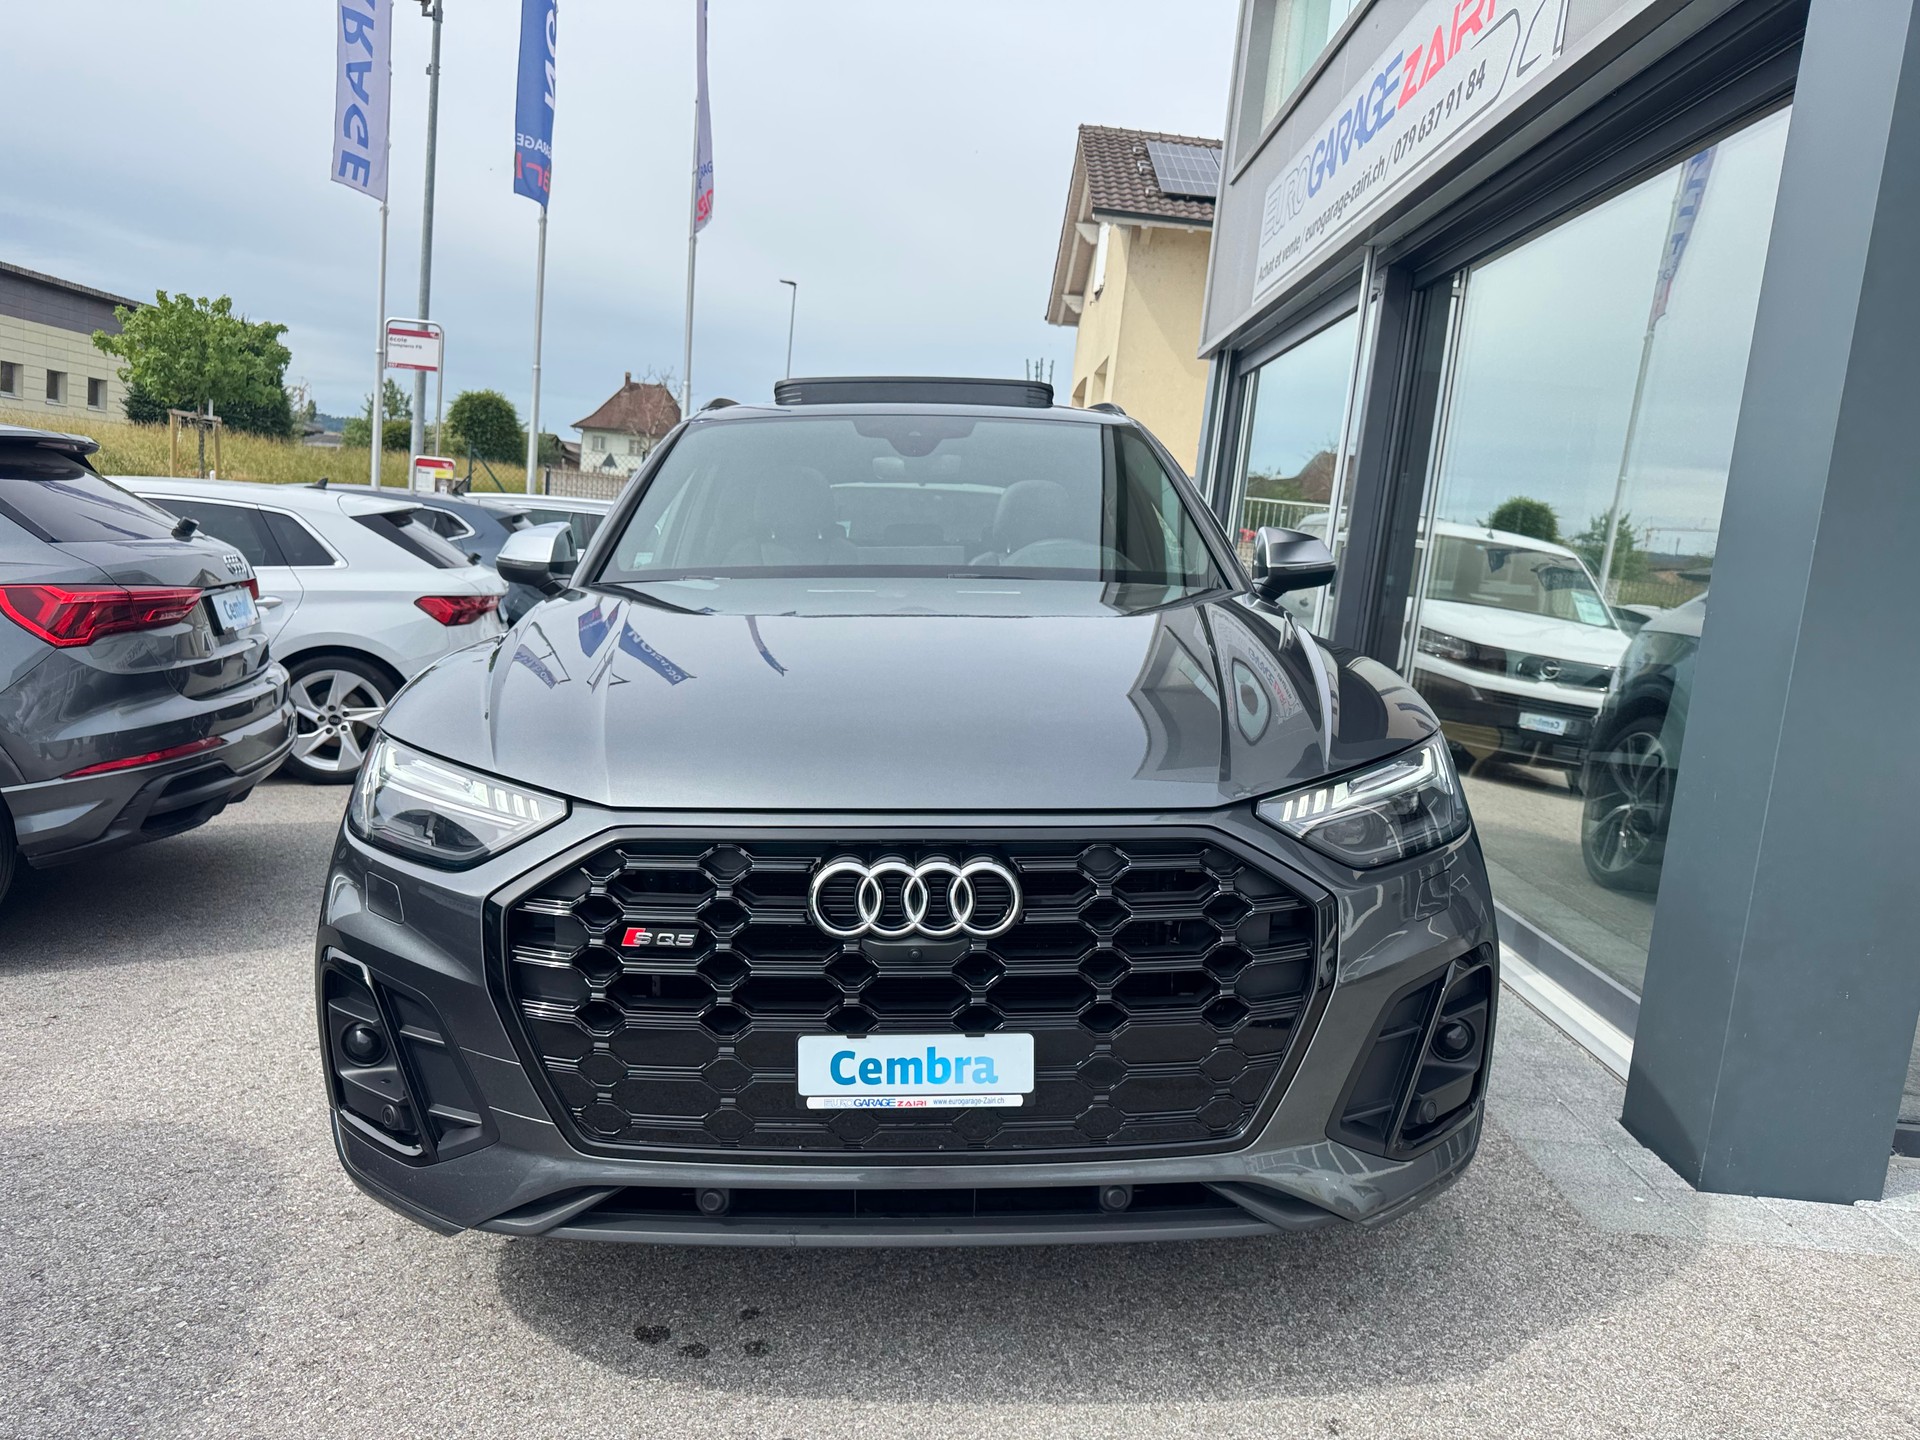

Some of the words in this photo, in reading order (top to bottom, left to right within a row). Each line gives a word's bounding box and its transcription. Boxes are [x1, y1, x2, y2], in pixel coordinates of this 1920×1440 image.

[1282, 235, 1301, 263] vente
[1393, 123, 1417, 165] 079
[1418, 98, 1444, 144] 637
[1446, 80, 1464, 120] 91
[1465, 58, 1487, 101] 84
[633, 932, 695, 946] SQ5
[830, 1046, 998, 1087] Cembra
